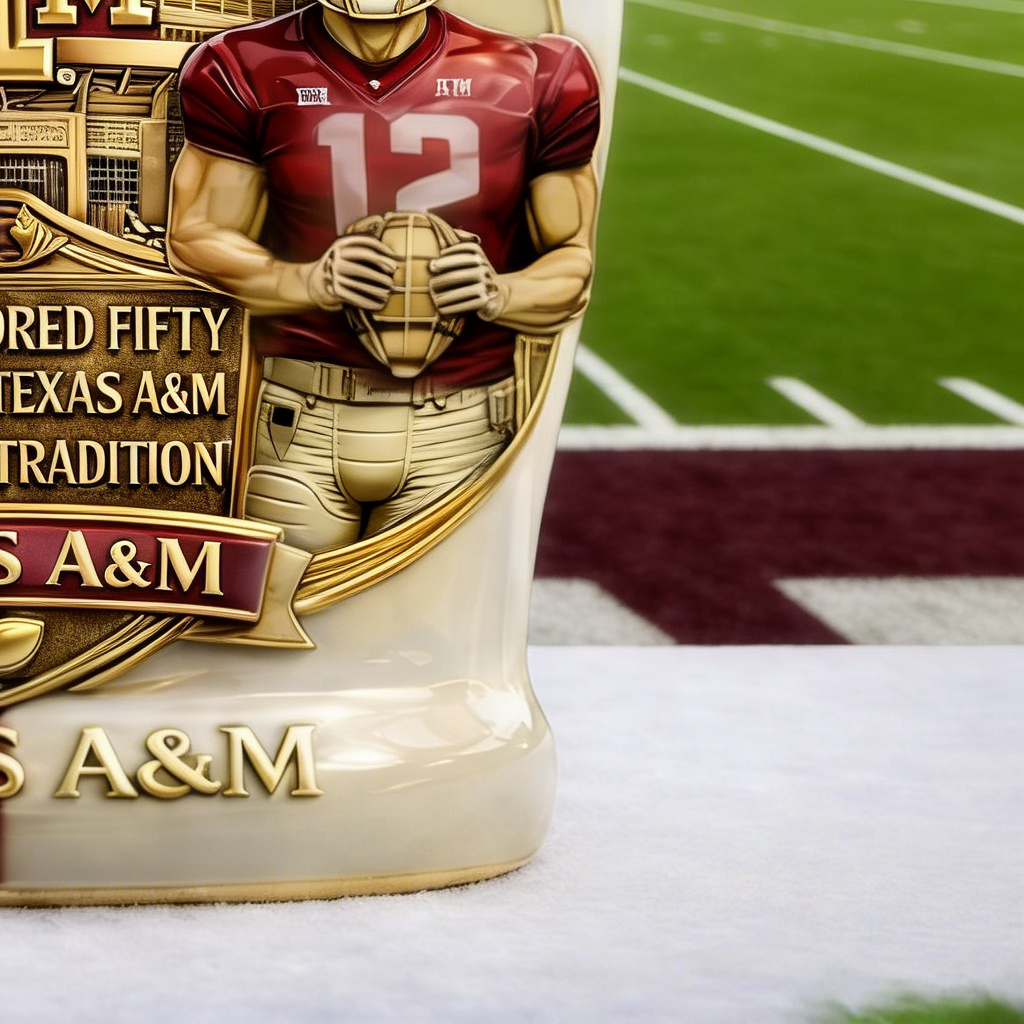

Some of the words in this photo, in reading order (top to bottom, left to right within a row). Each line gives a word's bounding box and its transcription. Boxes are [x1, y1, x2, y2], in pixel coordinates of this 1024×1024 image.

[317, 112, 480, 237] 12
[108, 305, 232, 353] FIFTY
[132, 370, 229, 416] A&M
[45, 528, 225, 597] A&M
[53, 724, 325, 800] A&M
